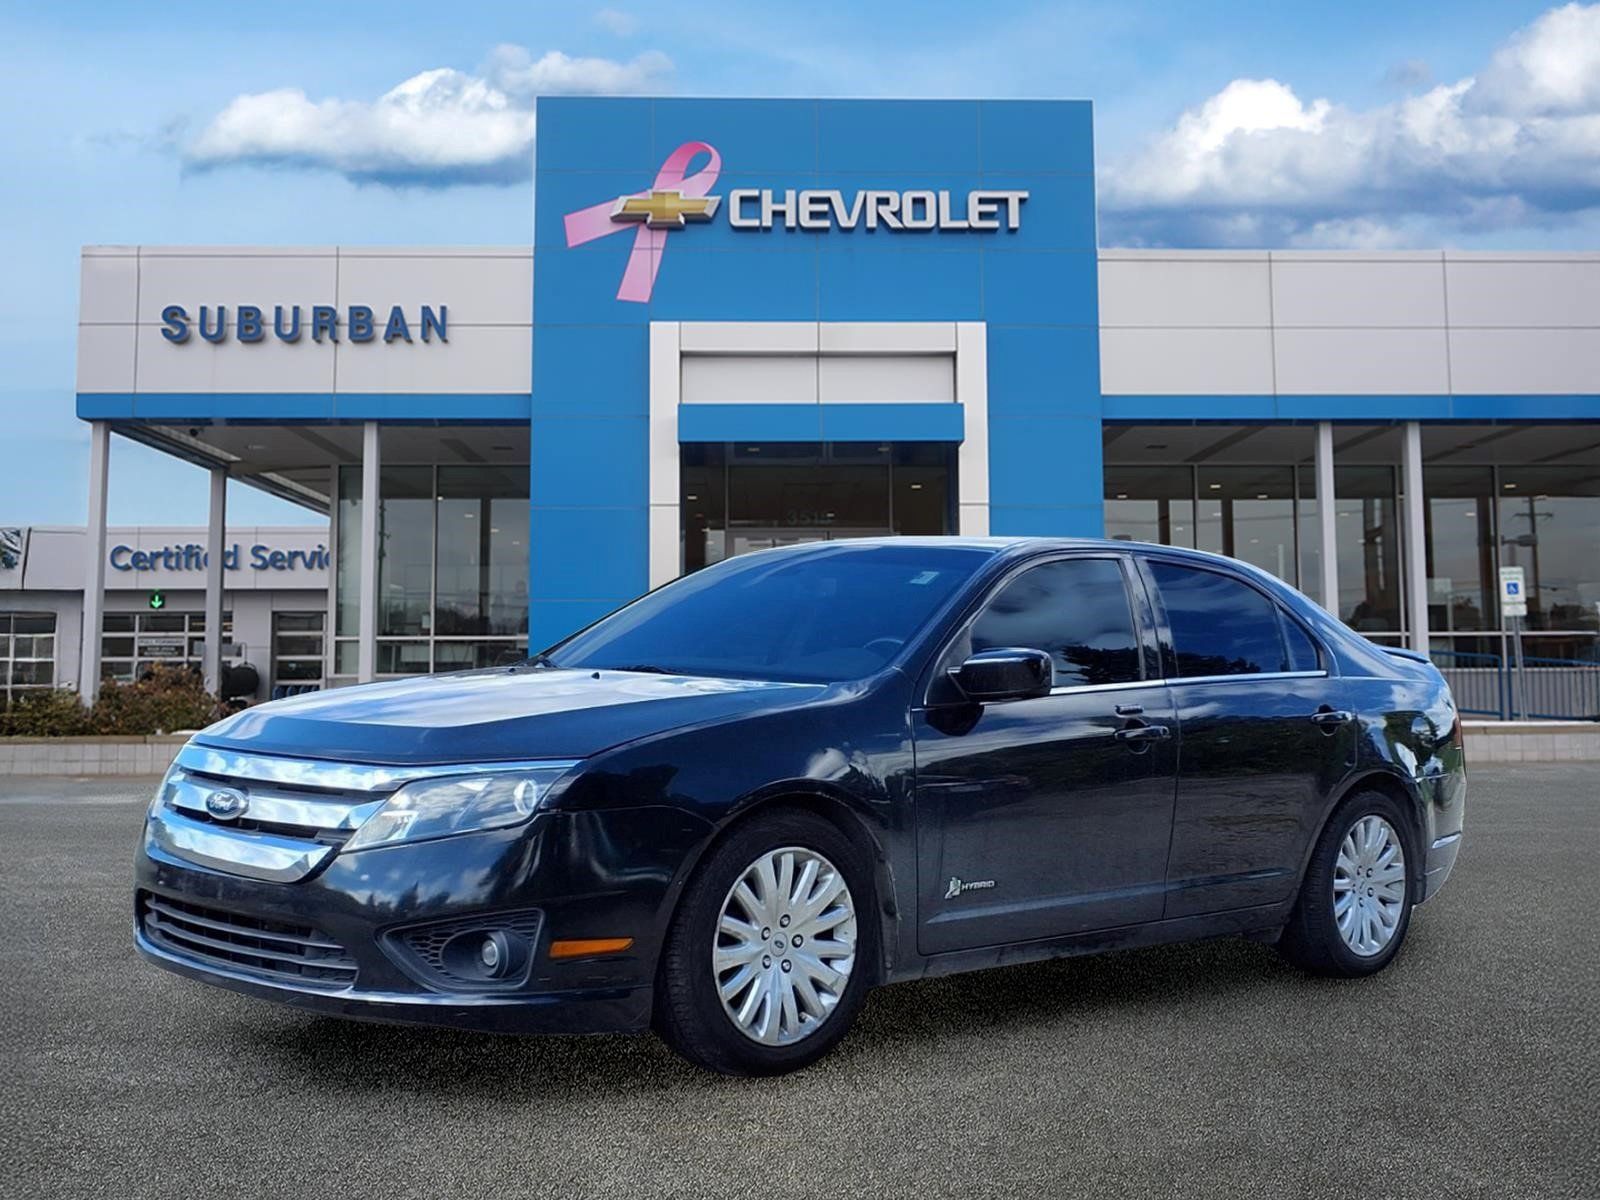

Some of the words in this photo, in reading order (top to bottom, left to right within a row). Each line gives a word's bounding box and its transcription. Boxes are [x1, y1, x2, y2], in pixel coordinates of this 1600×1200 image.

[729, 190, 1029, 231] CHEVROLET
[160, 304, 449, 344] SUBURBAN
[110, 544, 240, 571] Certifid
[210, 793, 234, 810] Ford
[962, 880, 994, 890] HYBRID
